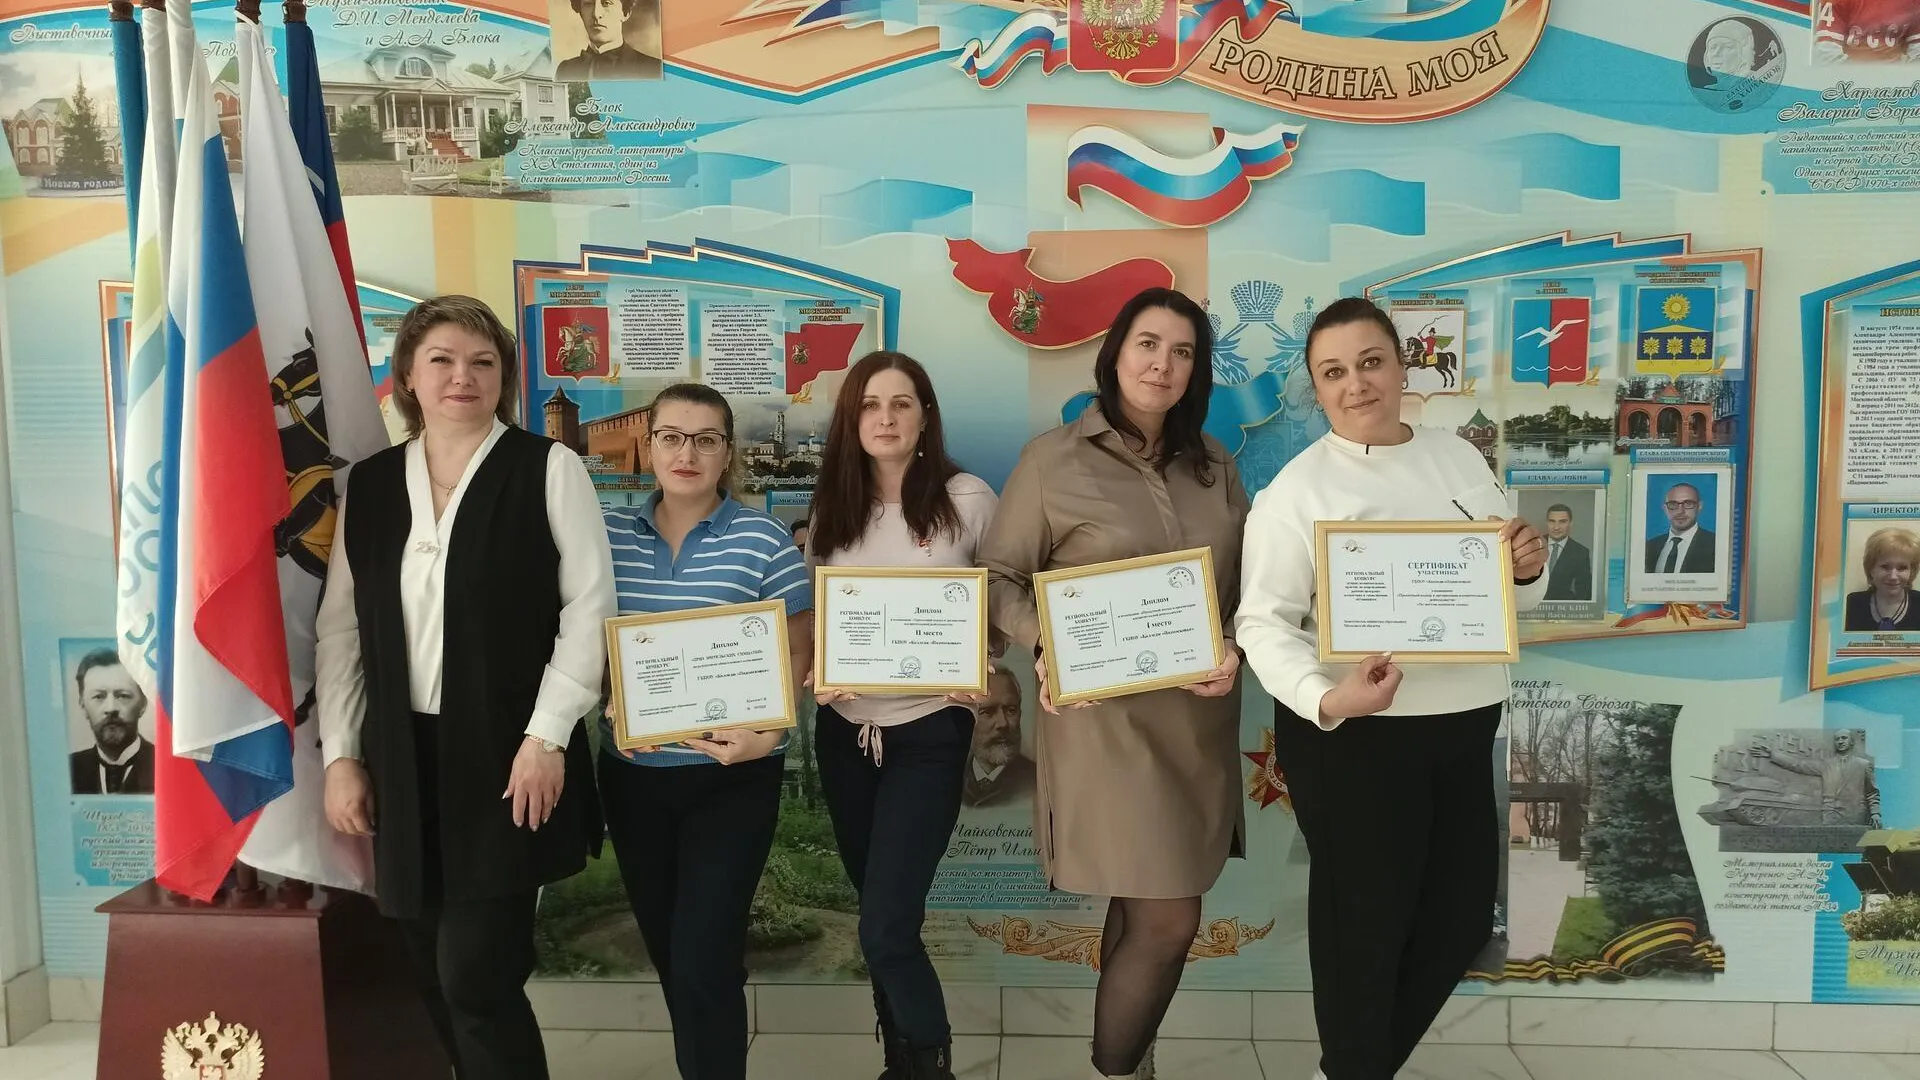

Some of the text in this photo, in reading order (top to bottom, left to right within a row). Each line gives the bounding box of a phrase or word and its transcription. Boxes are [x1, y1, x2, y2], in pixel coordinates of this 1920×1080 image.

[333, 8, 480, 28] Д.И. Менделеева
[366, 28, 501, 47] и А.А. Блока
[1210, 31, 1508, 102] РОДИНА МОЯ
[1822, 80, 1918, 103] Харламов
[576, 99, 622, 115] Блок
[1778, 103, 1860, 125] Валерий
[504, 116, 696, 136] Александр Александрович
[1779, 131, 1854, 144] Выдающийся
[1856, 131, 1906, 141] советский
[519, 144, 684, 159] Классик русской литературы
[1780, 144, 1845, 154] нападающий
[1848, 144, 1891, 152] команды
[561, 161, 616, 170] столетия,
[619, 158, 642, 169] один
[645, 161, 657, 169] из
[1824, 155, 1862, 167] сборной
[520, 170, 670, 184] величайших поэтов России.
[1794, 166, 1822, 178] Один
[1825, 169, 1836, 177] из
[1840, 167, 1881, 179] ведущих
[1809, 178, 1861, 190] СССР
[1865, 179, 1898, 188] 1970-х
[1407, 562, 1468, 570] СЕРТИФИКАТ
[1141, 597, 1169, 606] Диплом
[711, 641, 739, 650] Диплом
[1577, 693, 1631, 710] Союза
[953, 823, 1033, 838] Чайковский
[947, 840, 997, 861] Пётр
[1723, 857, 1832, 870] Мемориальная доска
[970, 870, 1033, 881] композитор,
[1725, 867, 1785, 880] Кучеренко
[954, 880, 977, 891] один
[980, 883, 991, 891] из
[1728, 879, 1776, 889] советский
[999, 895, 1040, 906] истории
[1041, 896, 1082, 908] музыки
[1724, 892, 1790, 902] конструктор,
[1793, 890, 1815, 900] один
[1714, 900, 1768, 911] создателей
